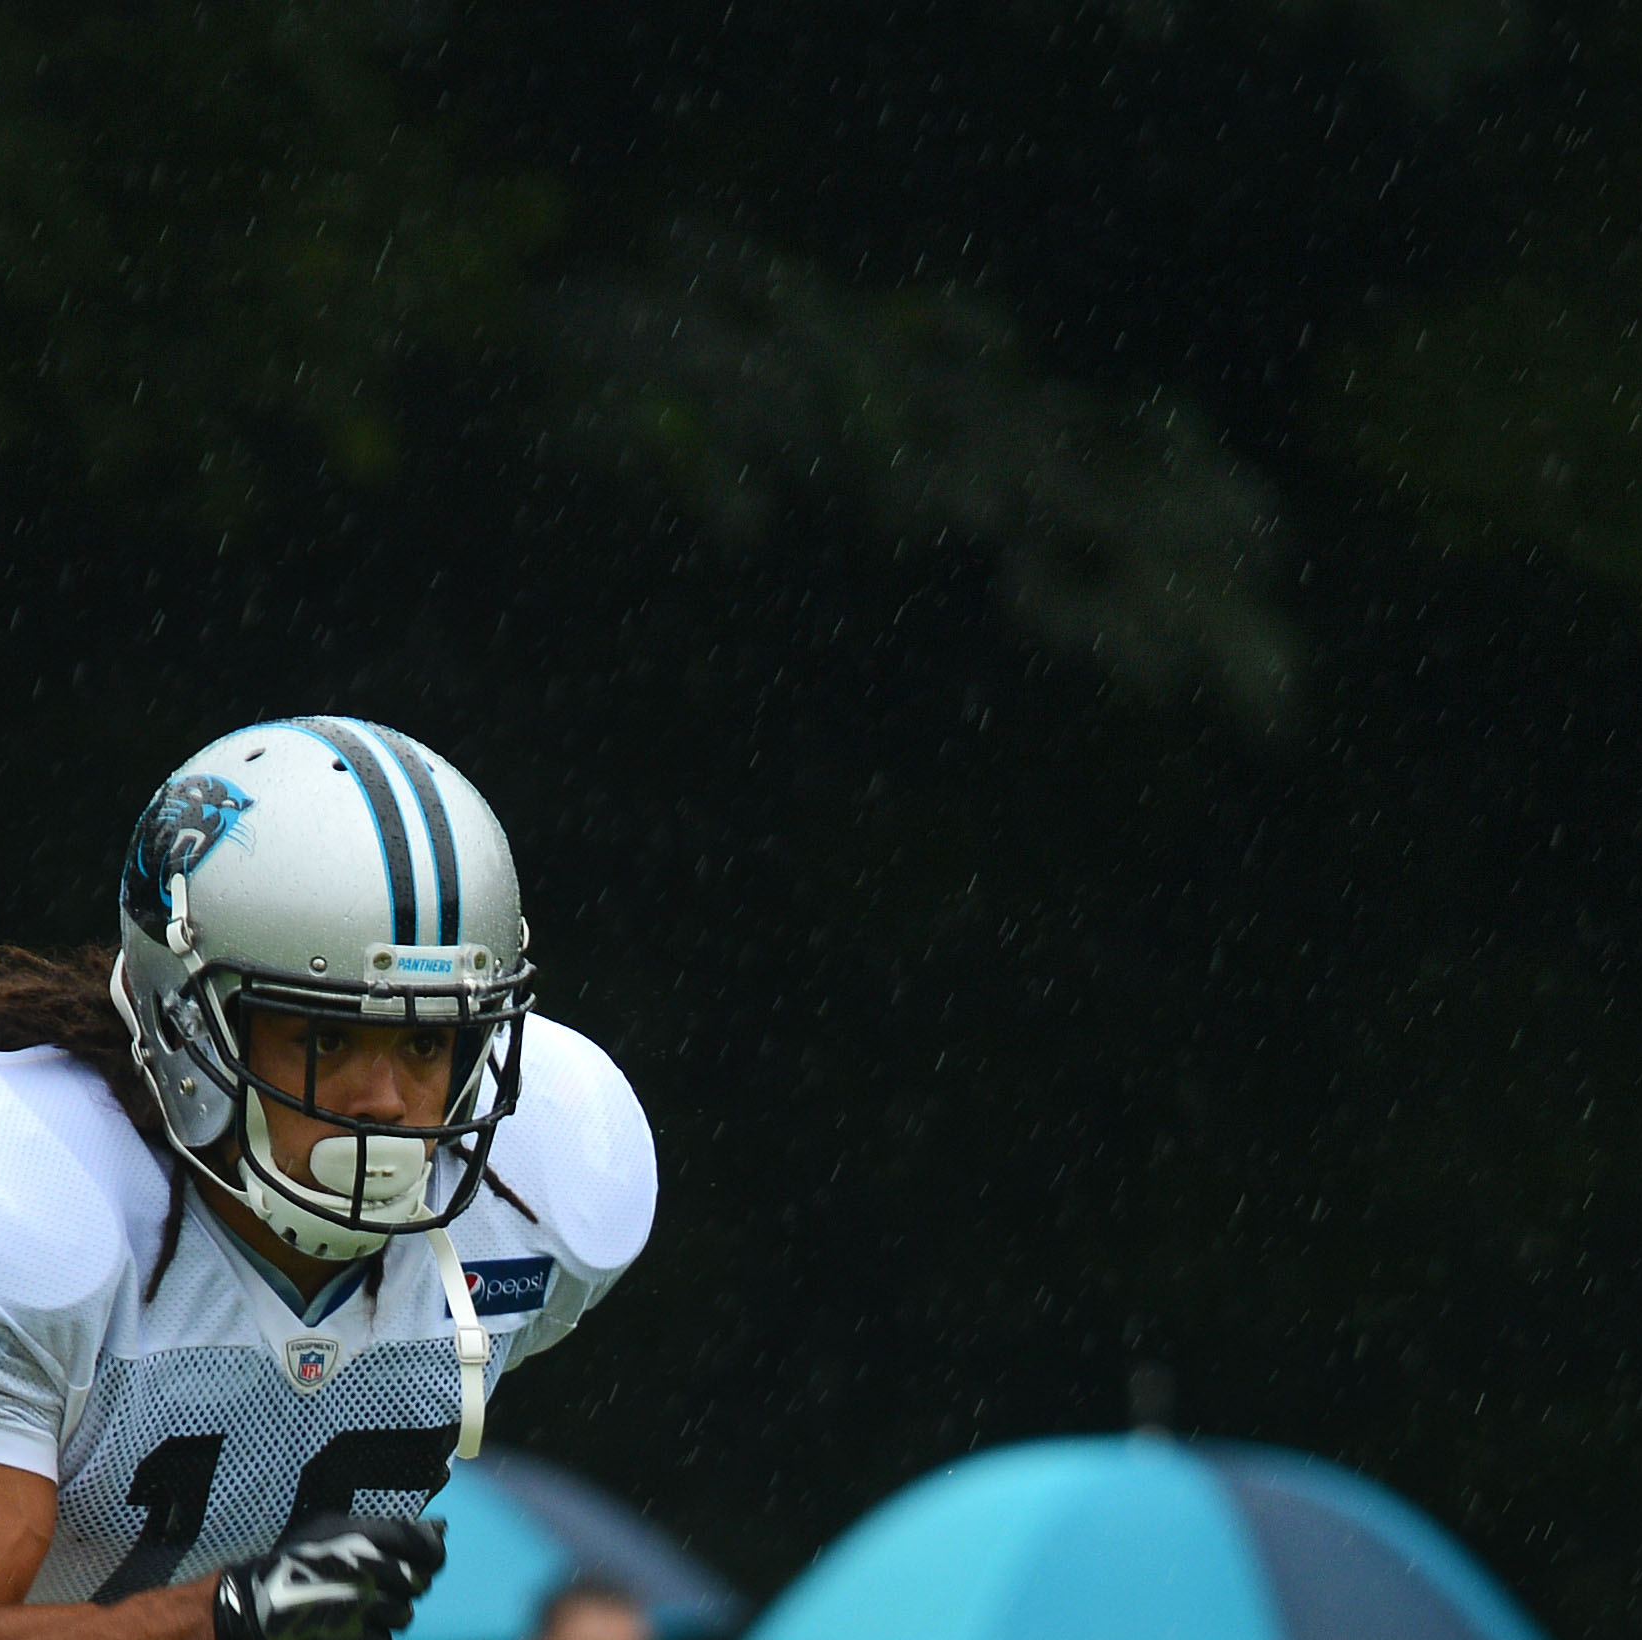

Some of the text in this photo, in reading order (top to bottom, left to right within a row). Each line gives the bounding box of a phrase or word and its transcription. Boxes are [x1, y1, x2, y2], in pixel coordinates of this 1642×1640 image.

[398, 958, 452, 973] PANTHERS
[486, 1271, 544, 1301] pepsi
[301, 1363, 322, 1379] NFL
